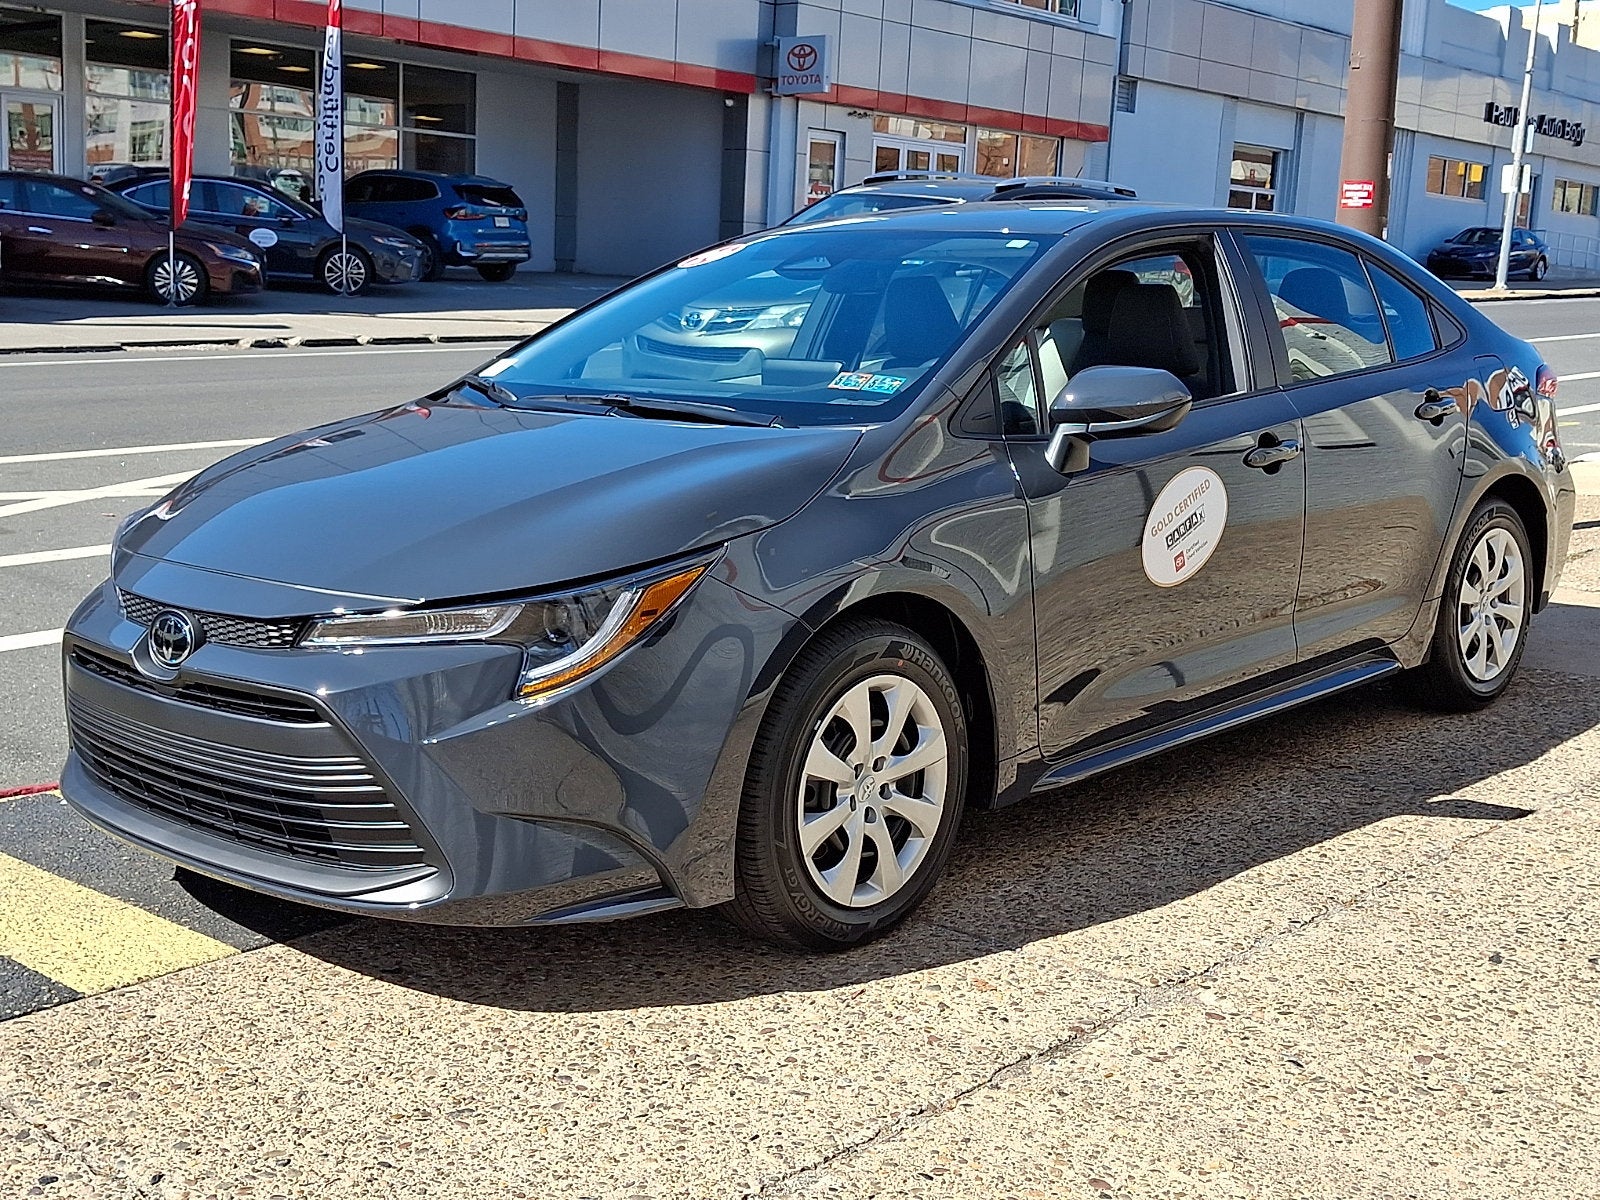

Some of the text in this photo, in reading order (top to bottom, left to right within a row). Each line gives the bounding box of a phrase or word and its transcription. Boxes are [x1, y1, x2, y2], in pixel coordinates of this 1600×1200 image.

[781, 74, 822, 86] TOYOTA
[1488, 102, 1516, 127] Paul
[1541, 115, 1563, 138] Auto
[1564, 120, 1587, 147] Body
[1151, 512, 1174, 538] GOLD
[1174, 478, 1211, 517] CERTIFIED
[1165, 507, 1206, 549] CARFAX
